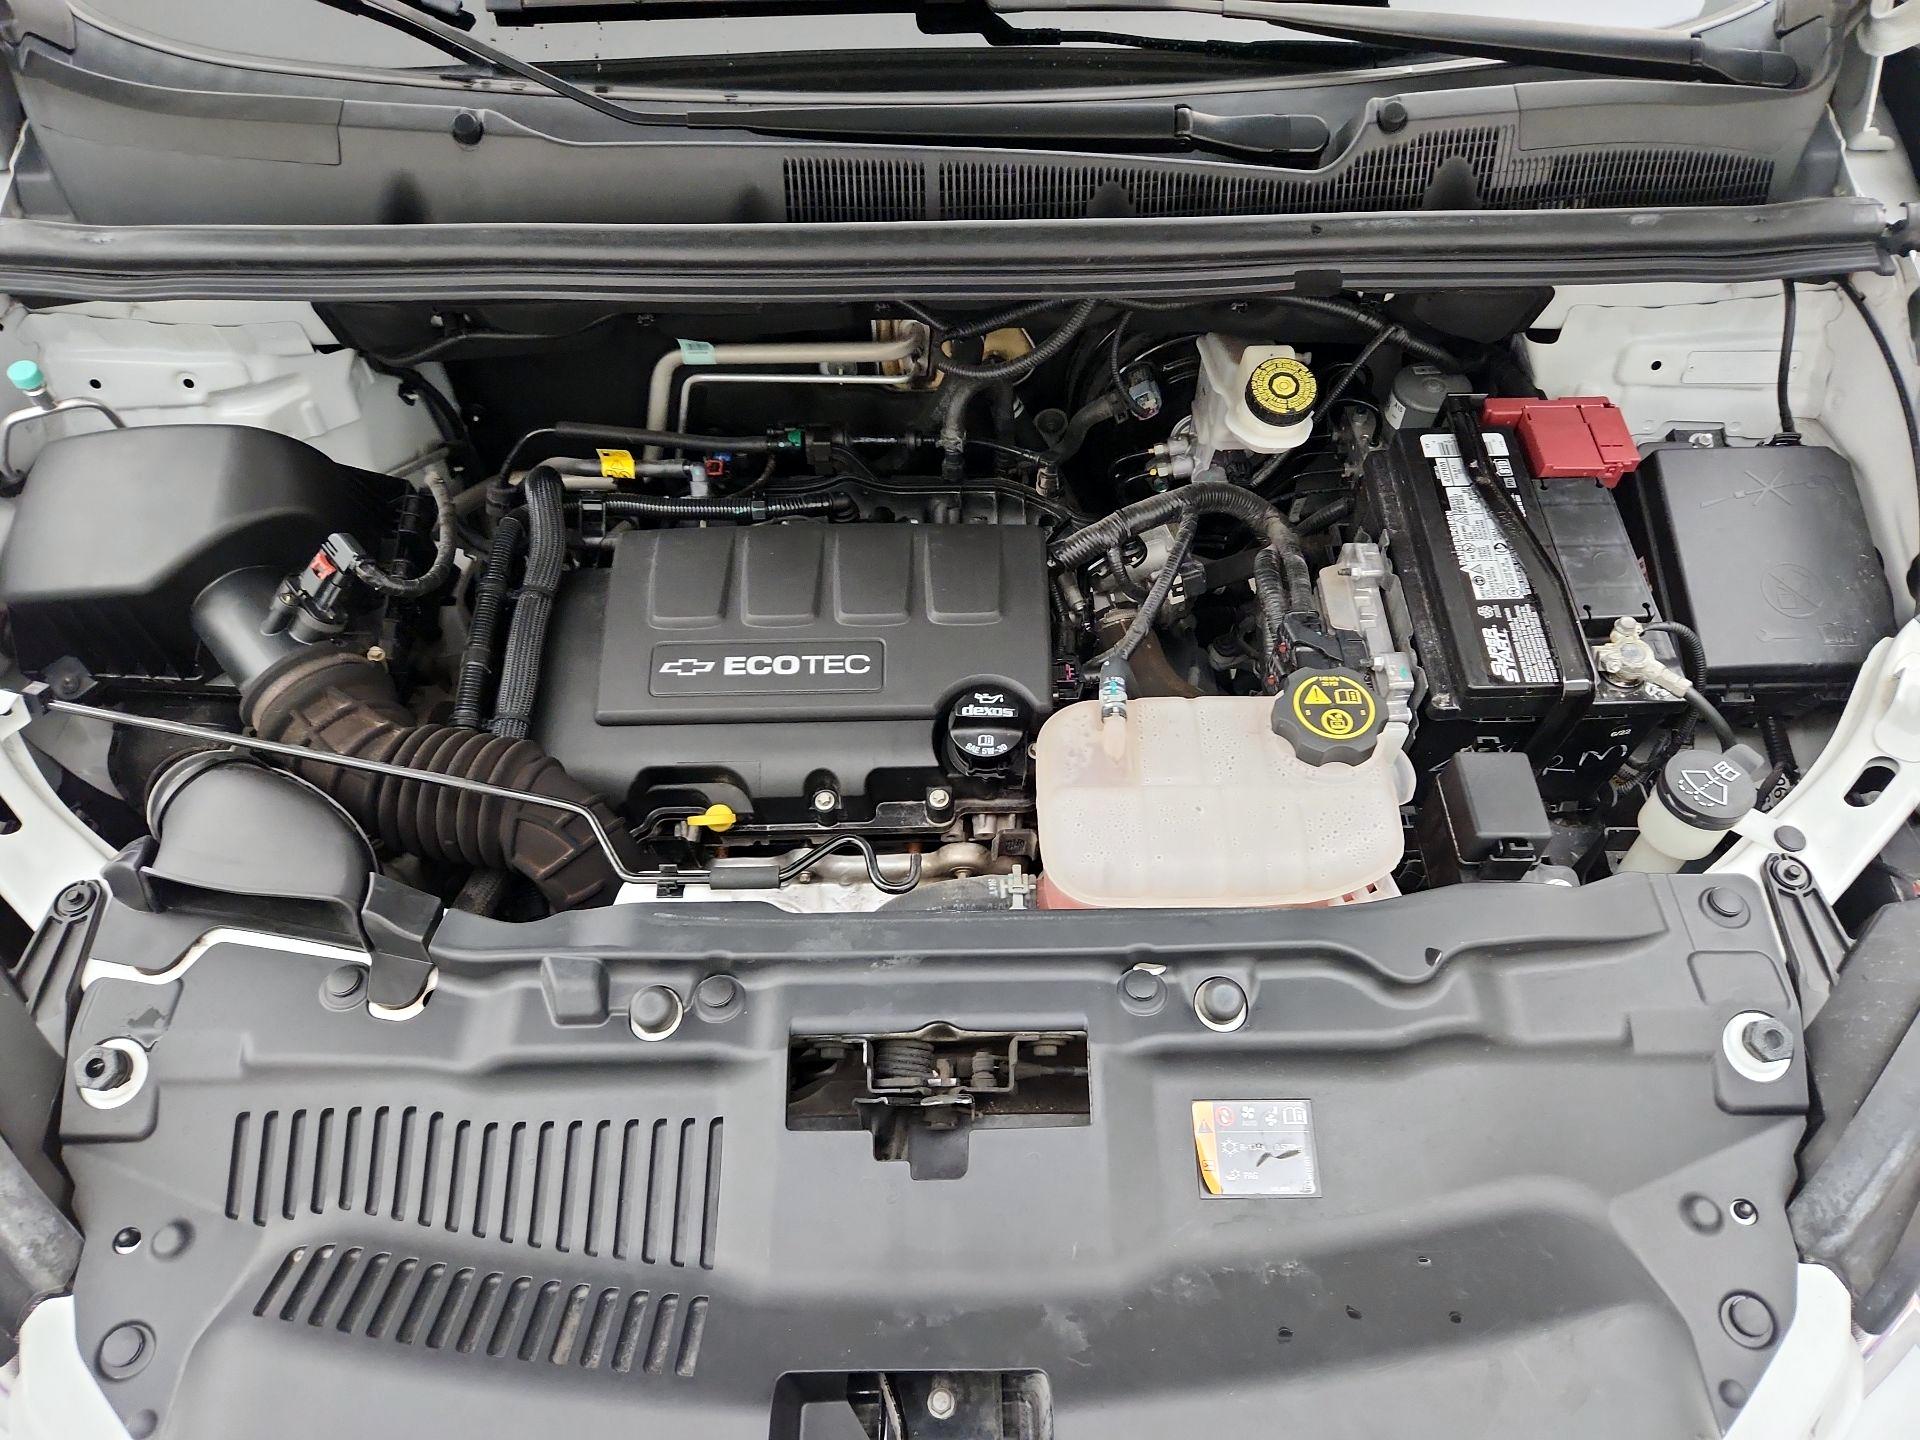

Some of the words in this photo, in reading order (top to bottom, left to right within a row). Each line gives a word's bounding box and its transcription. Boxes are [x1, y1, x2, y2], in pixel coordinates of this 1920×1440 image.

[1481, 627, 1503, 676] SUPER
[1497, 629, 1520, 682] START
[723, 654, 871, 676] ECOTEC
[962, 704, 1016, 717] dexos
[965, 742, 980, 754] SAE
[981, 743, 1008, 755] 5W-30
